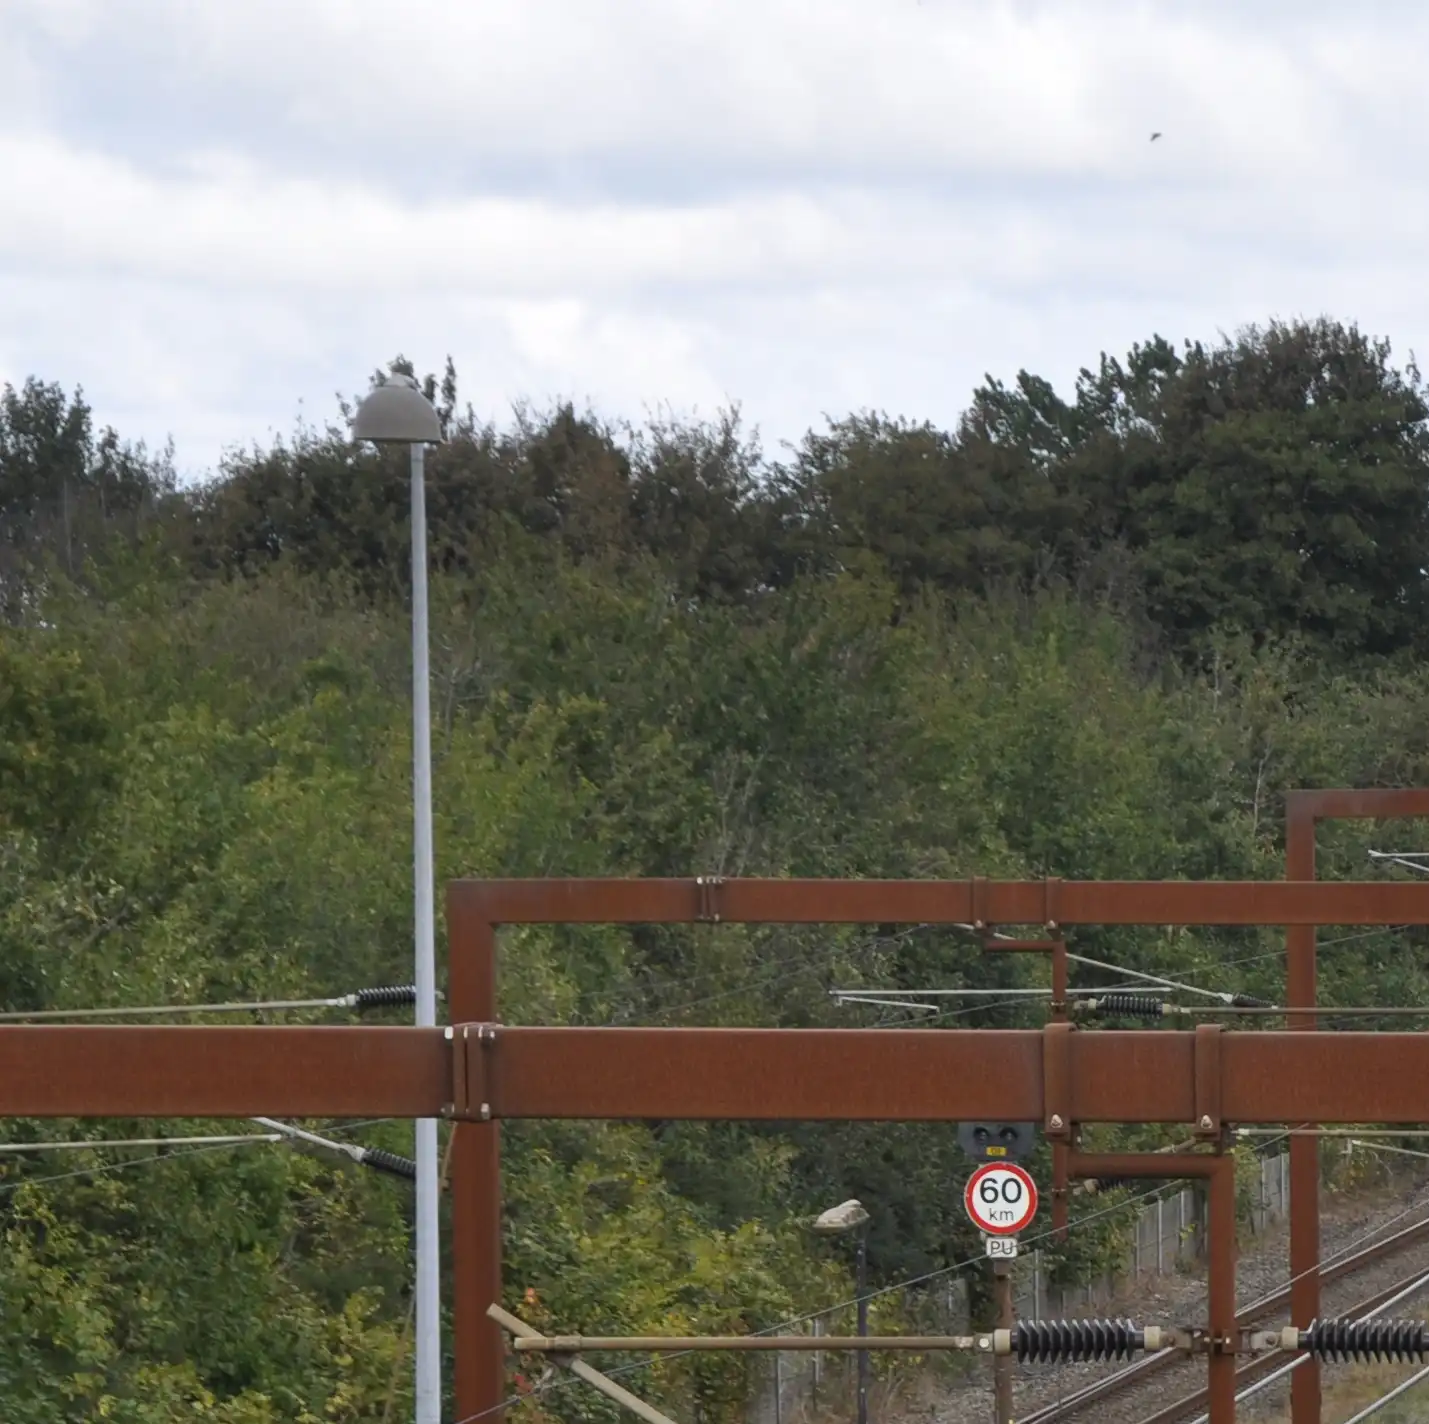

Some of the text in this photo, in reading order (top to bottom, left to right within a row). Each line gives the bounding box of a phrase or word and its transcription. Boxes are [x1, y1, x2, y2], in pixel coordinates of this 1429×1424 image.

[979, 1177, 1023, 1204] 60
[989, 1208, 1014, 1221] km
[990, 1240, 1014, 1255] PU
